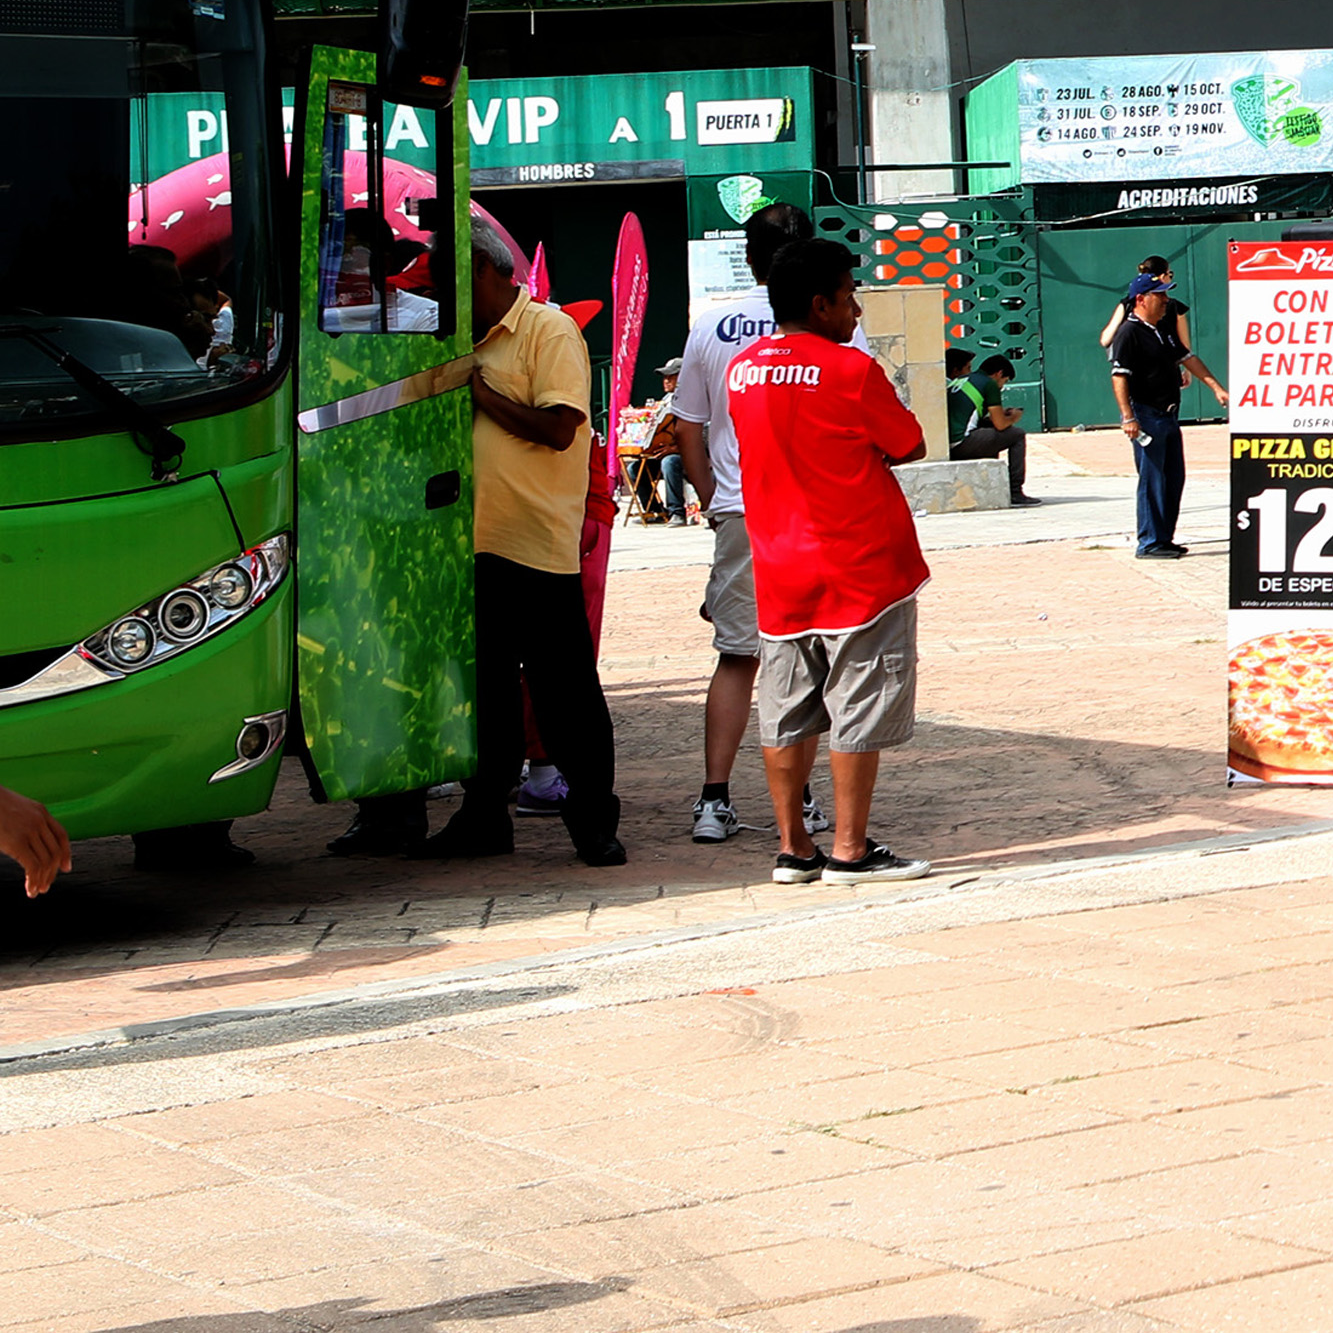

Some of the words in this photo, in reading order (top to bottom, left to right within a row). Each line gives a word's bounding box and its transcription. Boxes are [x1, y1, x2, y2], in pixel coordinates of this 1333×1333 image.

[1056, 88, 1071, 100] 23
[1122, 86, 1136, 98] 28
[1138, 85, 1164, 97] AGO.
[1184, 84, 1197, 95] 15
[1200, 83, 1224, 95] OCT.
[1057, 109, 1070, 119] 31
[1123, 106, 1136, 117] 18
[1139, 105, 1161, 116] SEP.
[1185, 104, 1198, 115] 29
[1201, 103, 1225, 114] OCT.
[187, 103, 429, 158] PEA
[467, 96, 559, 145] VIP
[608, 117, 638, 143] A
[665, 91, 686, 140] 1
[706, 114, 760, 131] PUERTA
[767, 113, 773, 128] 1
[1186, 124, 1198, 135] 19
[1201, 123, 1226, 134] NOV.
[1058, 129, 1071, 139] 14
[1073, 128, 1099, 139] AGO.
[1123, 127, 1137, 138] 24
[1140, 125, 1162, 137] SEP.
[519, 163, 595, 181] HOMBRES
[1117, 185, 1258, 208] ACREDITACIONES
[1273, 290, 1328, 313] CON
[716, 313, 779, 345] Cor
[729, 359, 821, 393] Corona
[1238, 384, 1274, 407] AL
[1232, 438, 1306, 459] PIZZA
[1259, 578, 1282, 592] DE
